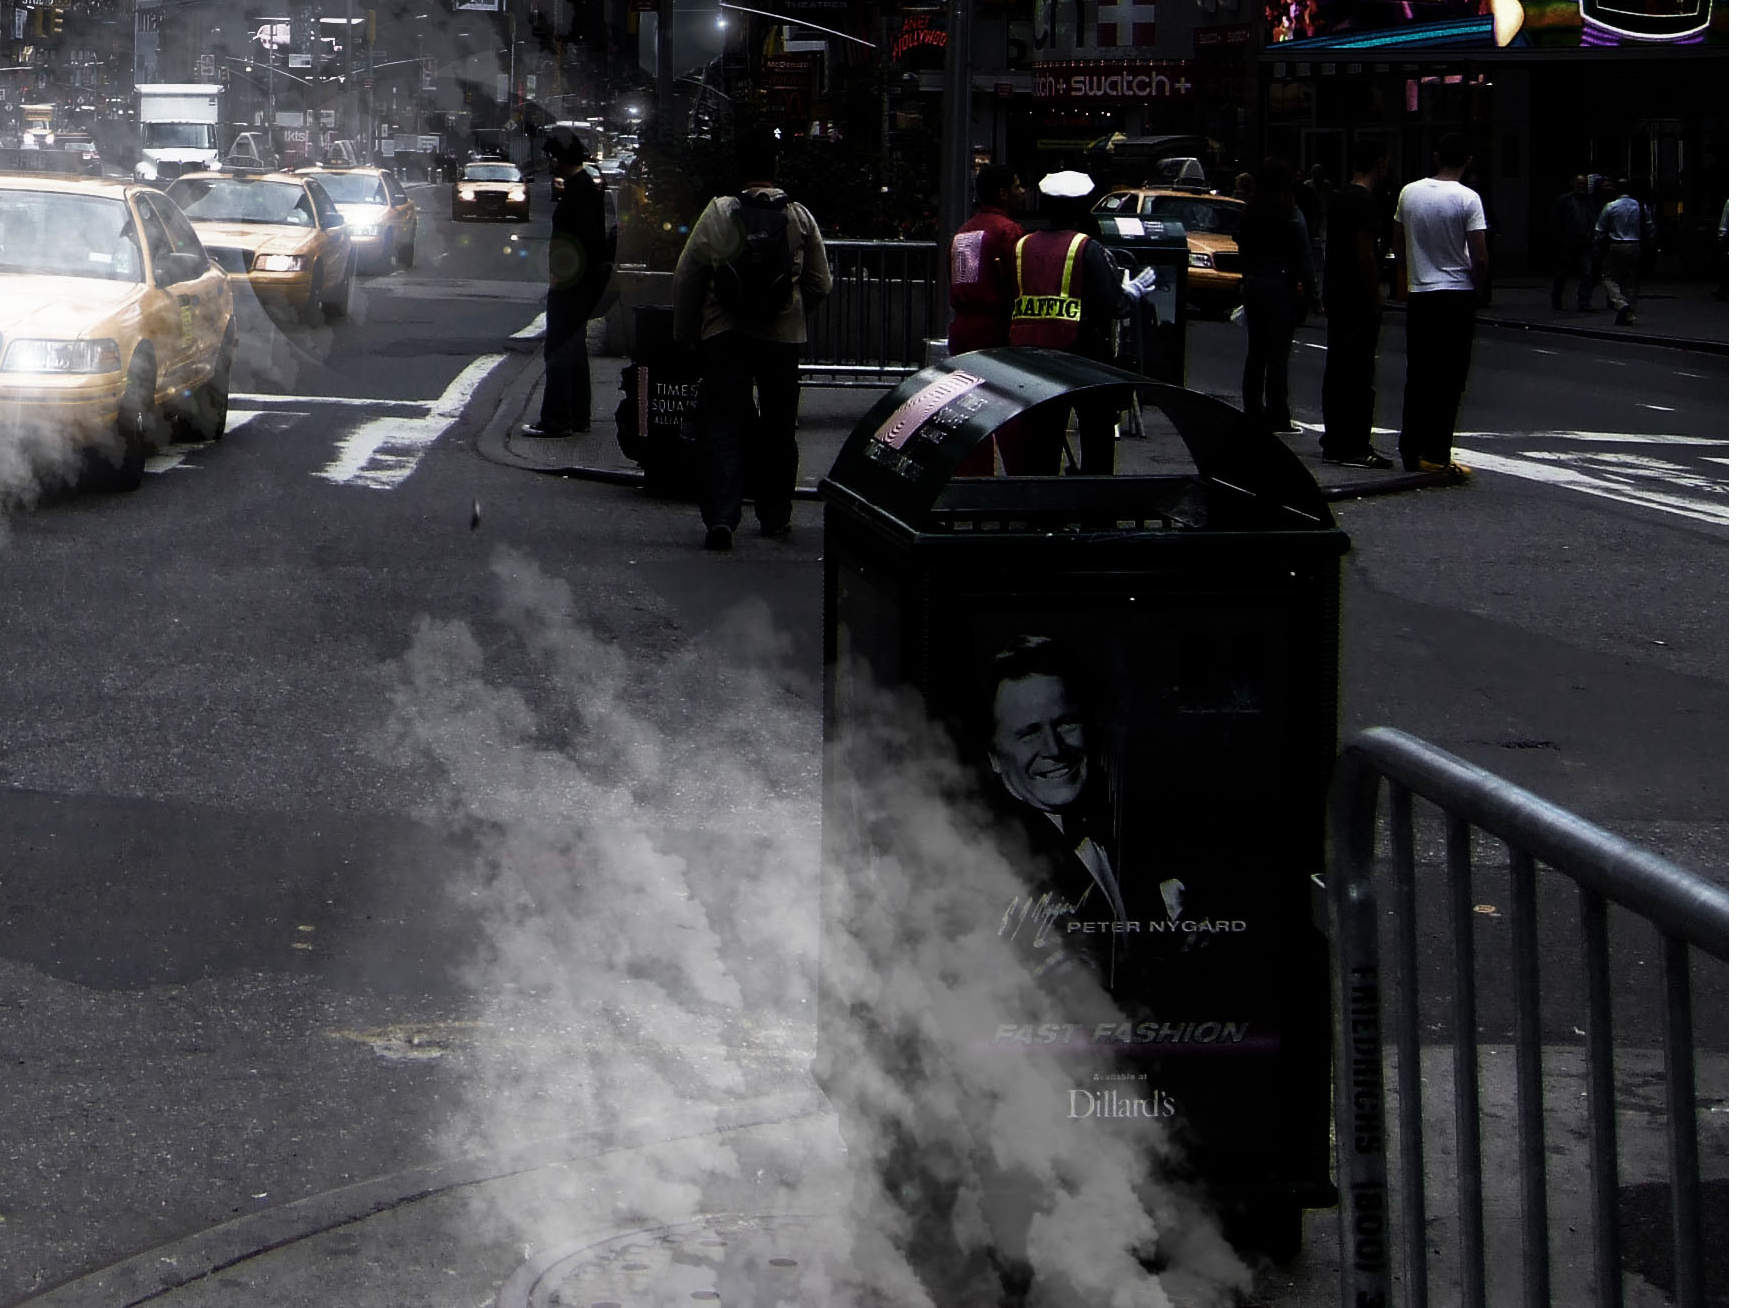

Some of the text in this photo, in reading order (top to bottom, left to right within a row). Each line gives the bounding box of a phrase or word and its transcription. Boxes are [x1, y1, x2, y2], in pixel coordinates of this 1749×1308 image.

[655, 382, 699, 397] TIMES
[1066, 920, 1142, 934] PETER
[991, 1021, 1249, 1046] FAST FASHION
[1066, 1088, 1177, 1120] Dillard's
